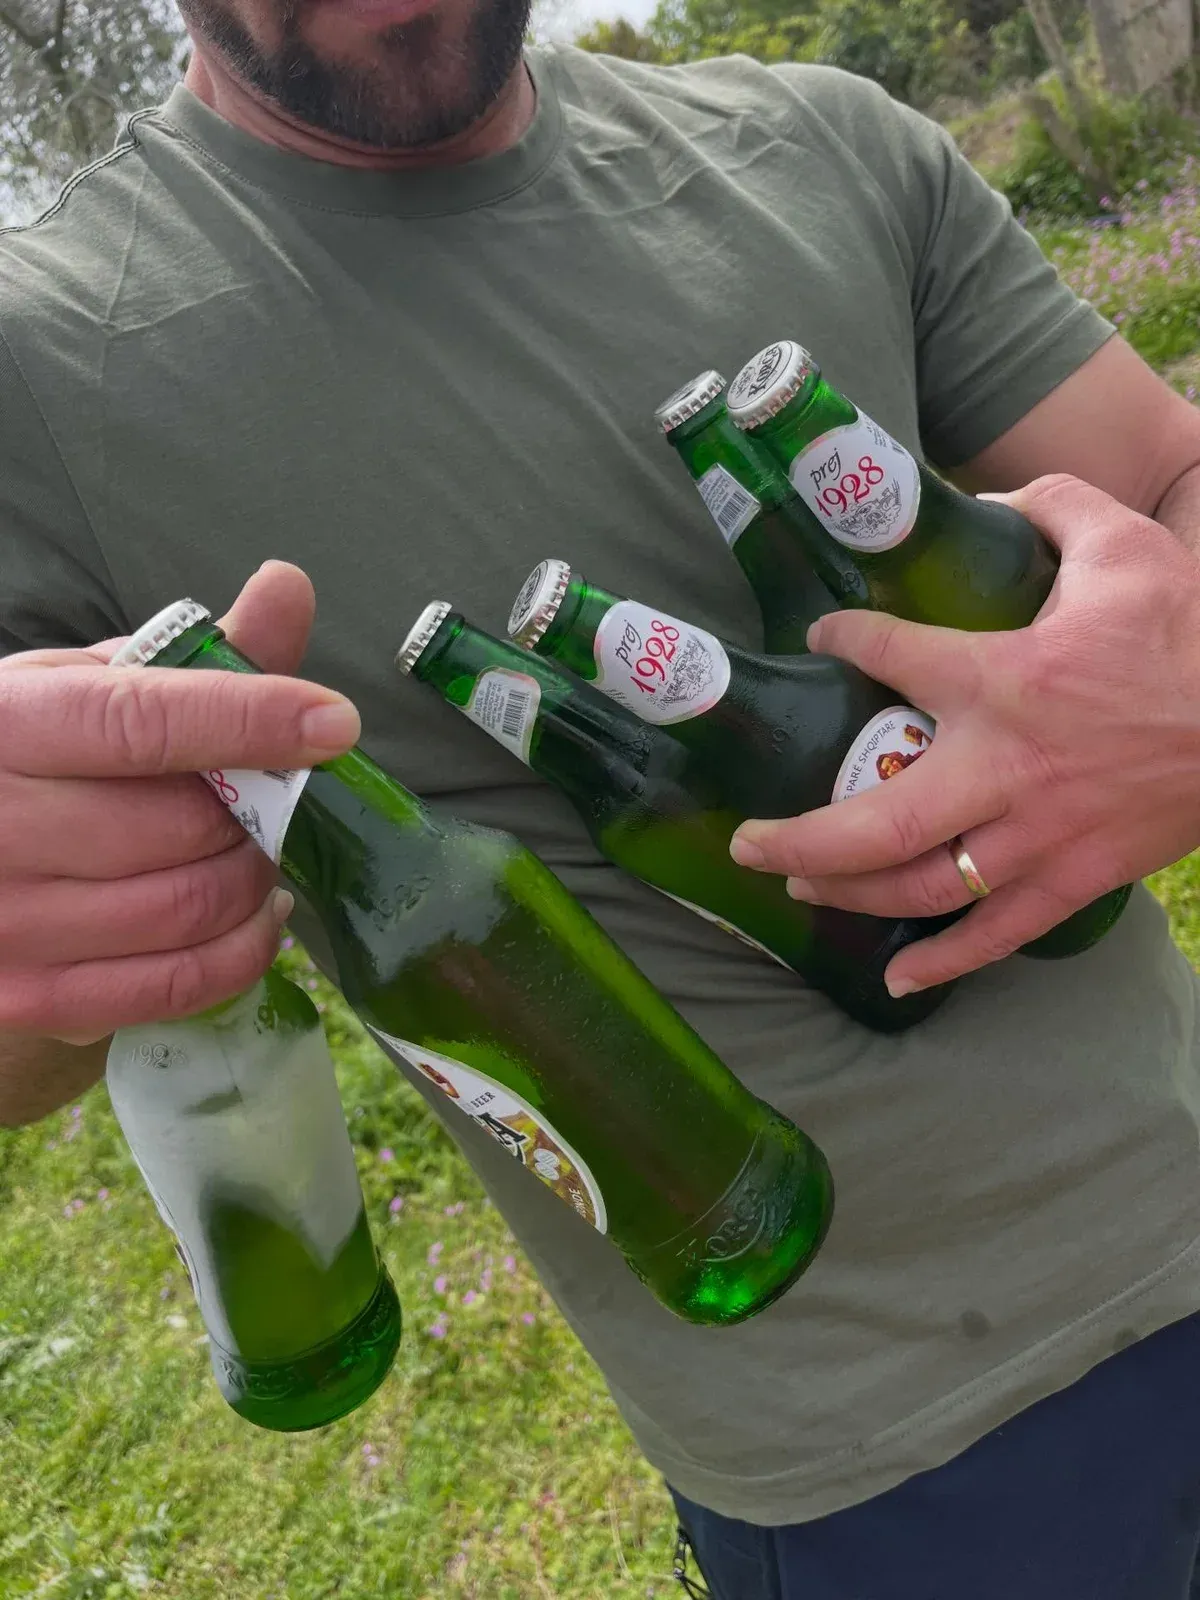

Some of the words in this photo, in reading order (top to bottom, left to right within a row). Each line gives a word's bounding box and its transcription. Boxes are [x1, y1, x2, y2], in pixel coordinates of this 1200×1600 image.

[810, 447, 842, 491] prej
[814, 455, 884, 517] 1928
[615, 619, 643, 669] prej
[630, 620, 680, 693] 1928
[858, 720, 897, 764] SHQIPTARE
[470, 1091, 496, 1108] BEER
